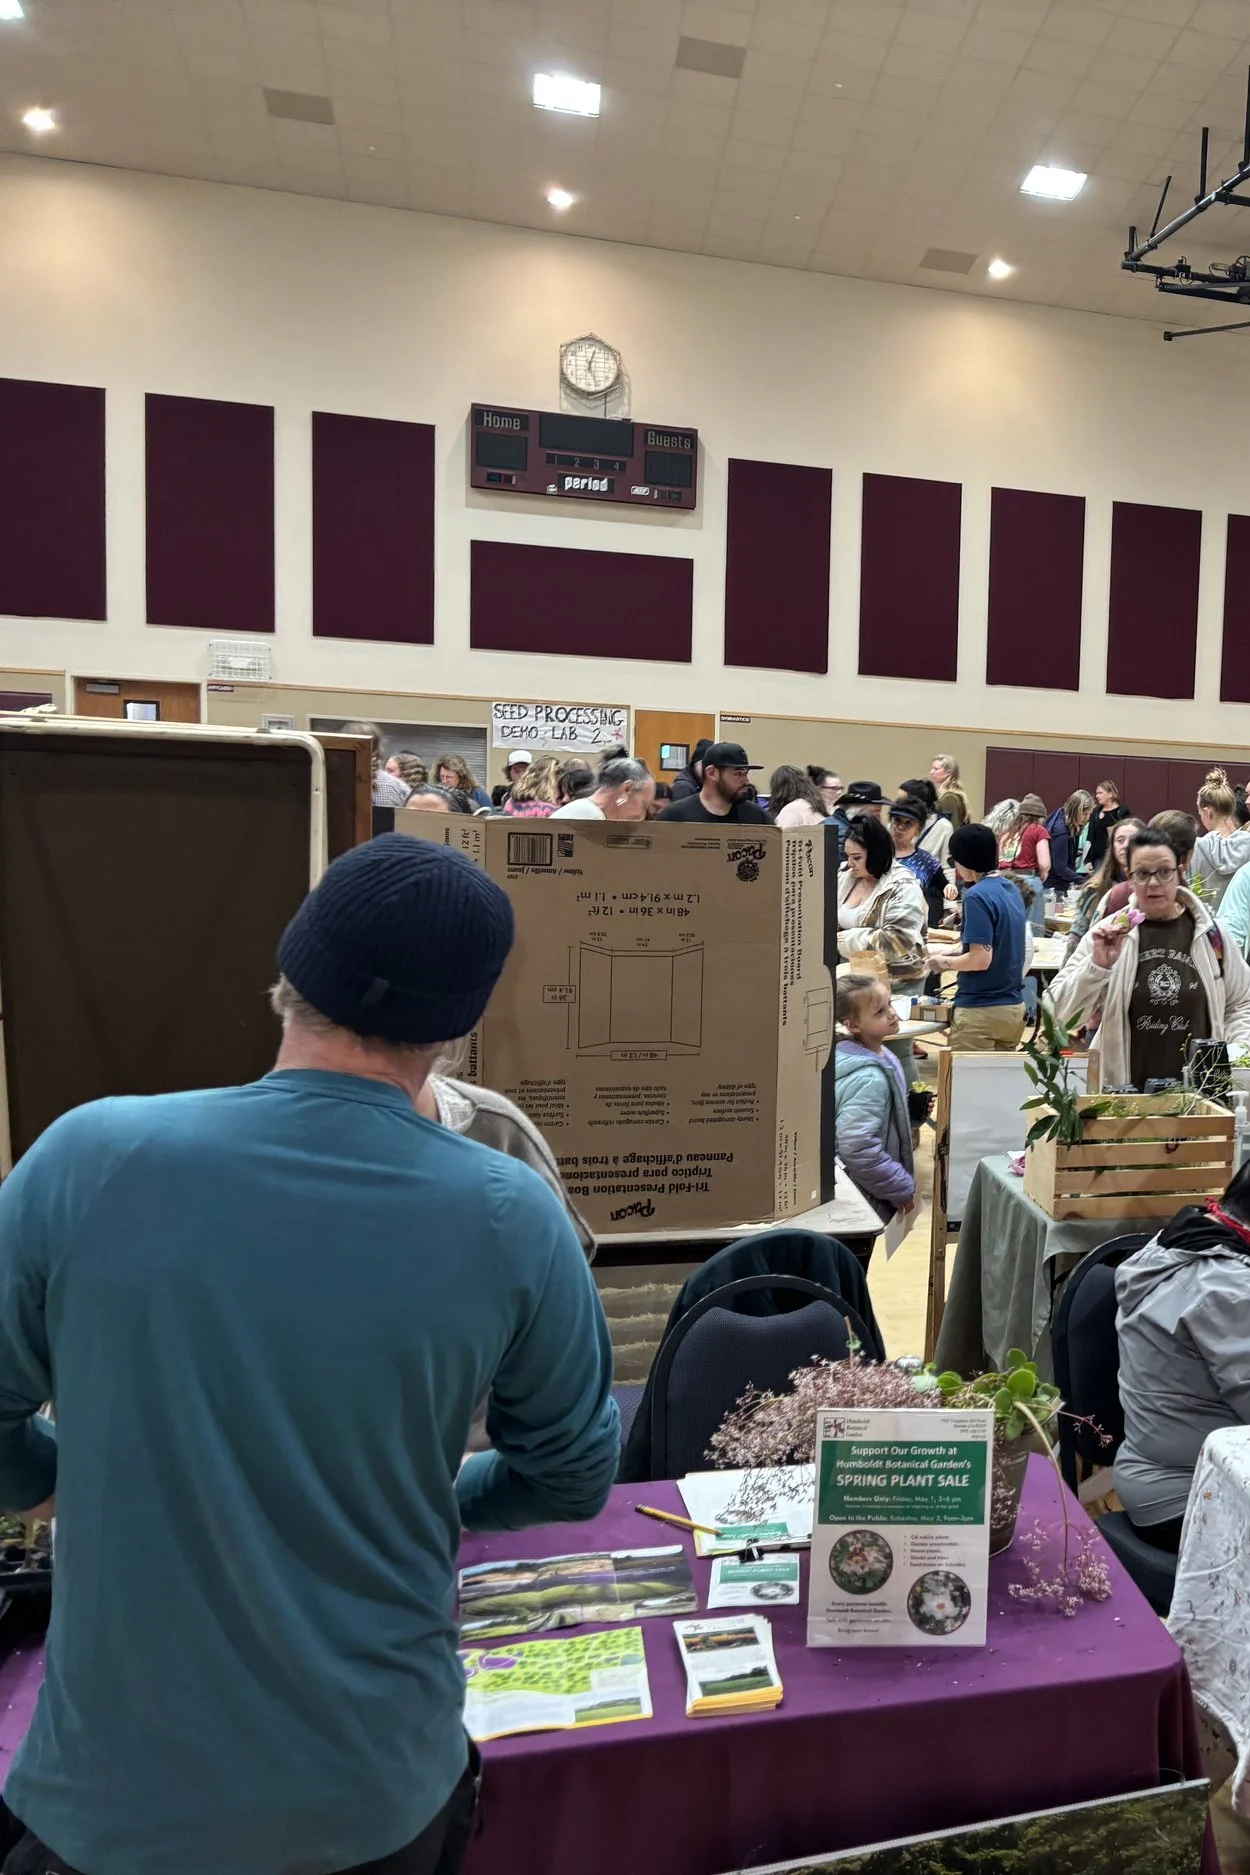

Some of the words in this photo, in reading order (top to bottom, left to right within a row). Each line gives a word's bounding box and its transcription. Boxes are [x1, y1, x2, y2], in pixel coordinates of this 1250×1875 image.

[483, 411, 521, 430] Home
[647, 431, 691, 449] Guests
[574, 457, 580, 467] 2
[594, 459, 600, 469] 3
[613, 461, 620, 471] 4
[564, 476, 608, 492] period
[492, 703, 528, 720] SEED
[535, 705, 625, 726] PROCESSING
[500, 725, 538, 739] DEMO
[551, 725, 577, 740] LAB
[727, 843, 766, 862] Pacon
[594, 892, 605, 902] 1.1
[621, 892, 638, 900] cm
[640, 893, 661, 903] 91.4
[687, 894, 700, 904] 1.2
[602, 906, 613, 916] 12
[629, 907, 639, 916] in
[640, 907, 654, 917] 36
[666, 907, 676, 916] in
[677, 907, 690, 917] 48
[1136, 1015, 1169, 1035] Riding
[467, 1032, 478, 1077] battants
[556, 1156, 579, 1168] batt
[582, 1155, 609, 1166] trois
[612, 1155, 619, 1166] à
[622, 1152, 683, 1166] d'affichage
[686, 1152, 734, 1163] Panneau
[560, 1167, 639, 1182] presentacion
[643, 1166, 668, 1178] para
[568, 1185, 590, 1197] Boa
[593, 1183, 665, 1196] Presentation
[668, 1182, 710, 1195] Tri-Fold
[610, 1198, 656, 1222] Pacon
[851, 1446, 888, 1456] Support
[890, 1446, 908, 1456] Our
[910, 1446, 946, 1456] Growth
[947, 1446, 957, 1455] at
[836, 1460, 884, 1469] Humboldt
[885, 1460, 929, 1469] Botanical
[930, 1459, 972, 1469] Garden's
[836, 1474, 887, 1487] SPRING
[891, 1474, 935, 1487] PLANT
[937, 1474, 970, 1487] SALE
[914, 1495, 928, 1503] May
[829, 1514, 847, 1522] Open
